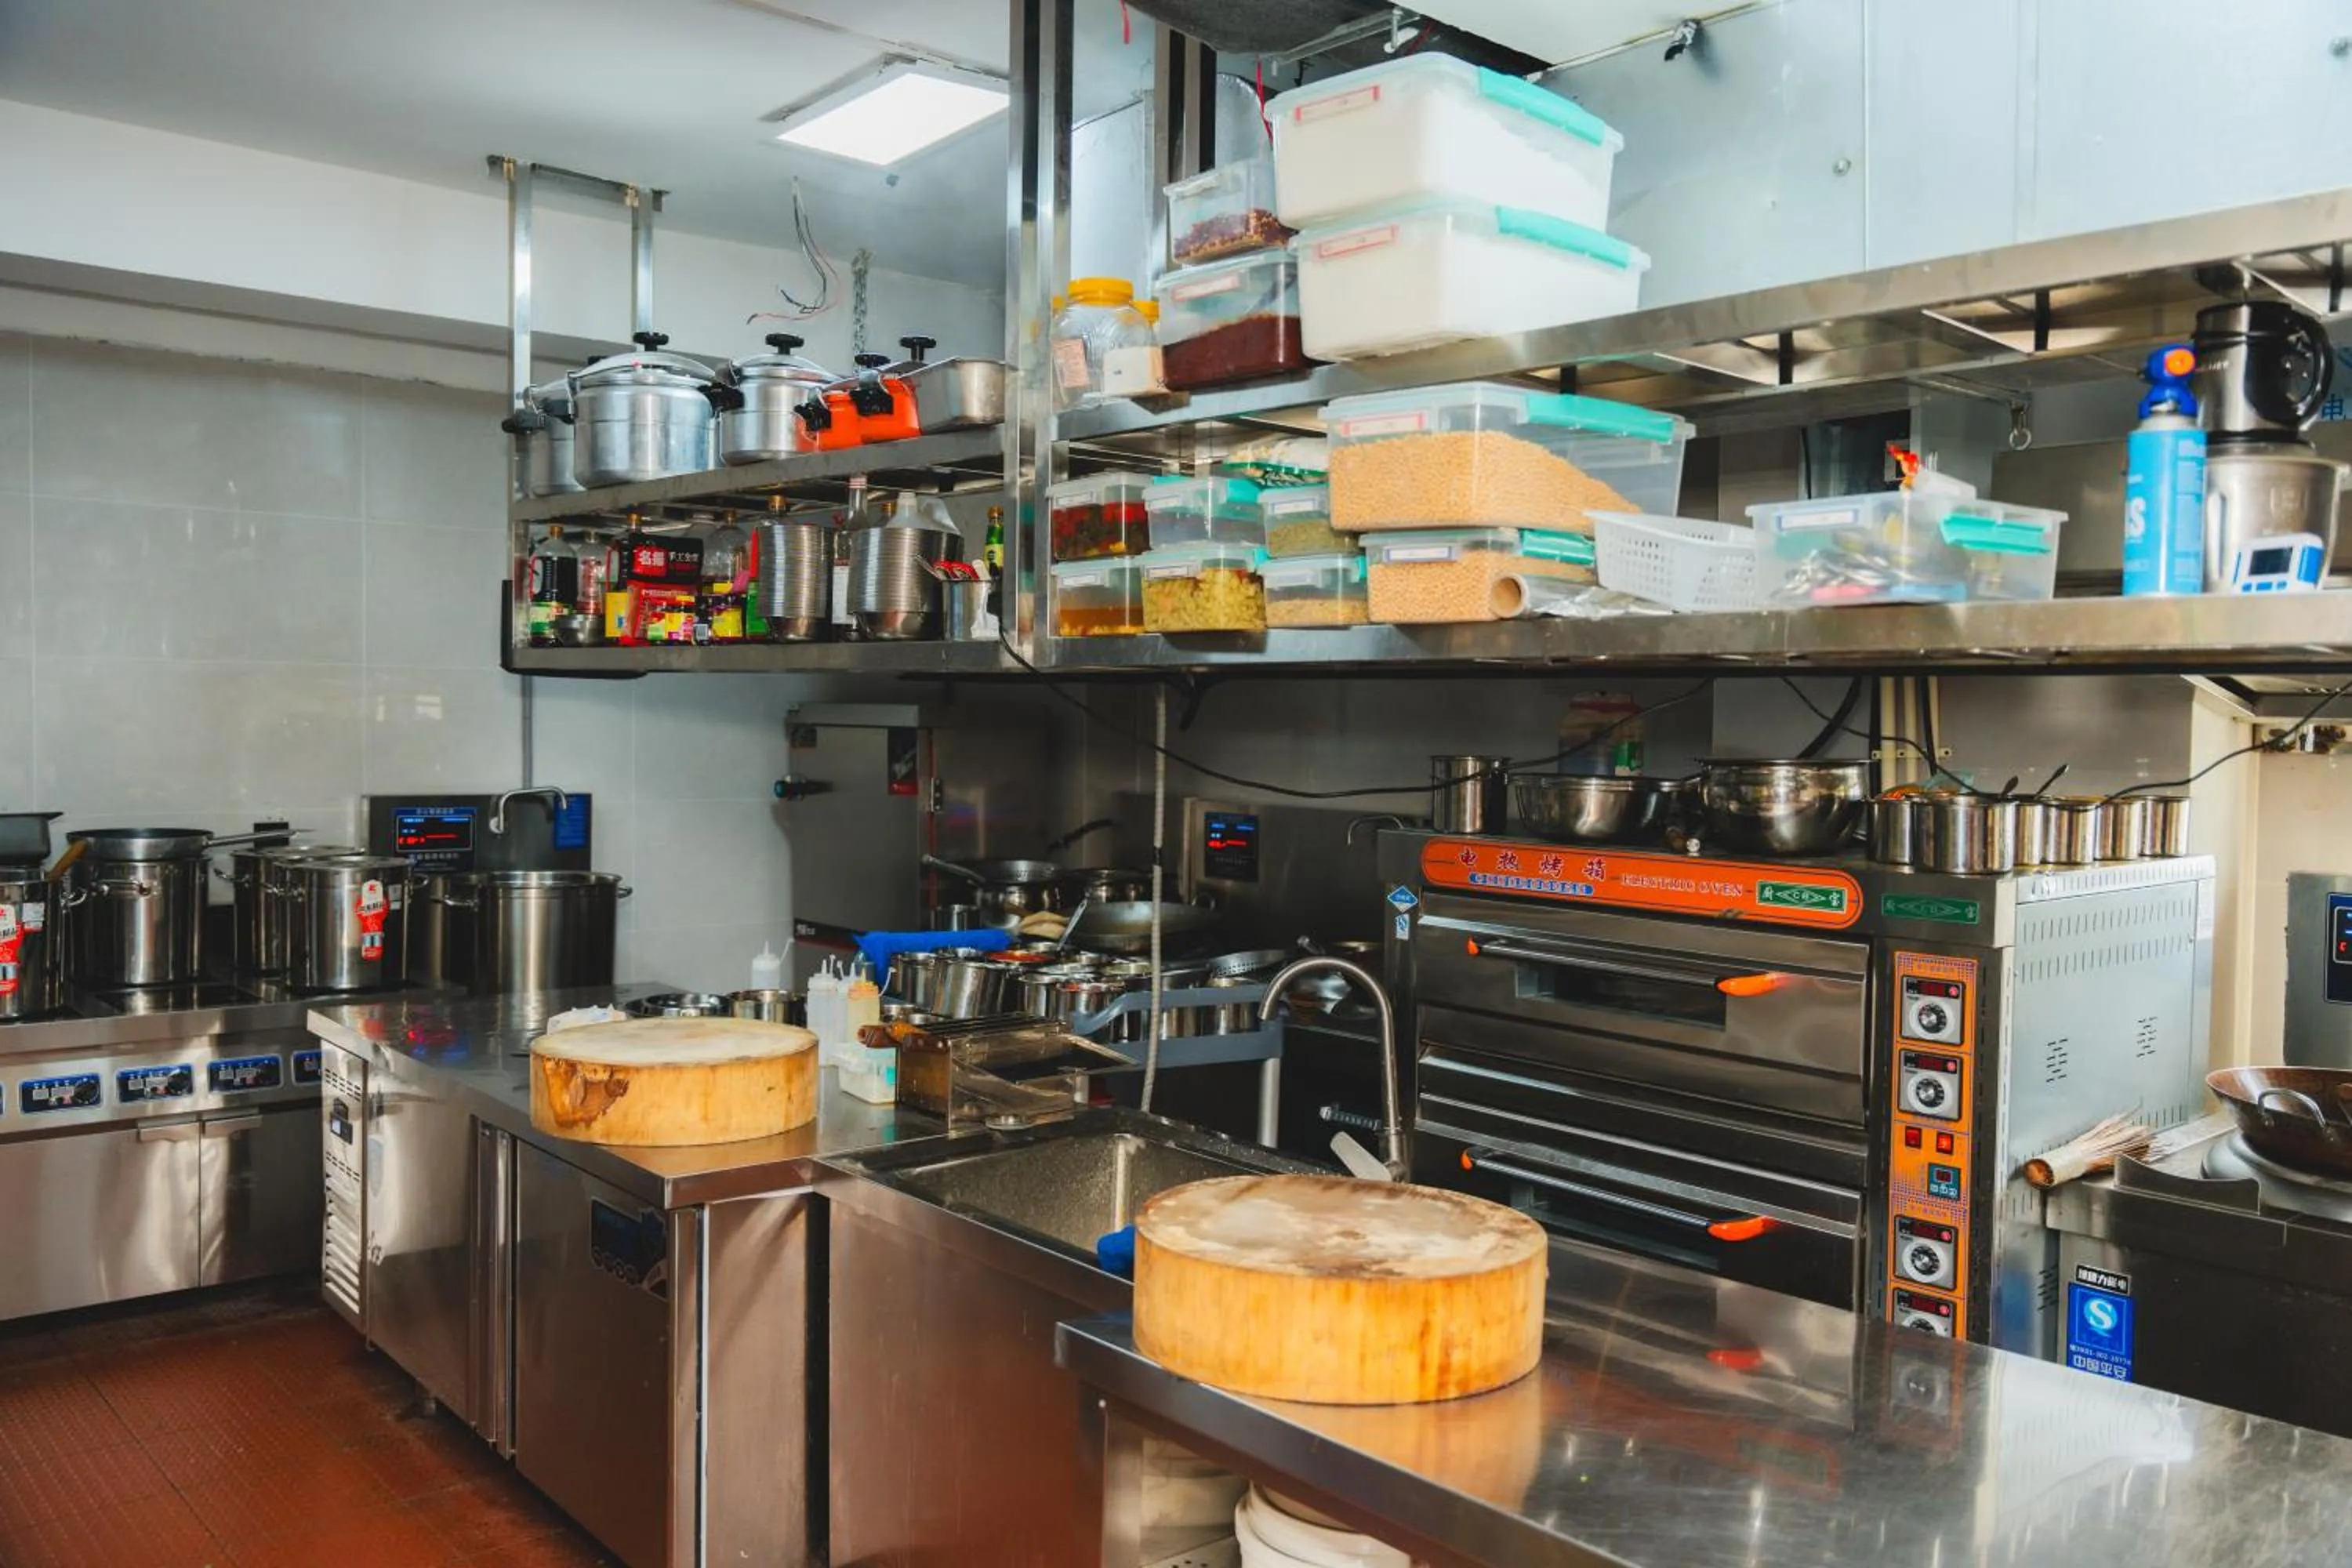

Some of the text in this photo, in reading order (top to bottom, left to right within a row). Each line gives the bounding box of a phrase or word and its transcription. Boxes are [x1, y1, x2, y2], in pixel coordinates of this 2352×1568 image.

[1459, 847, 1606, 881] 电热烤箱
[1622, 873, 1744, 897] ELECTRIC OVEN
[2072, 1354, 2128, 1381] 中国平安
